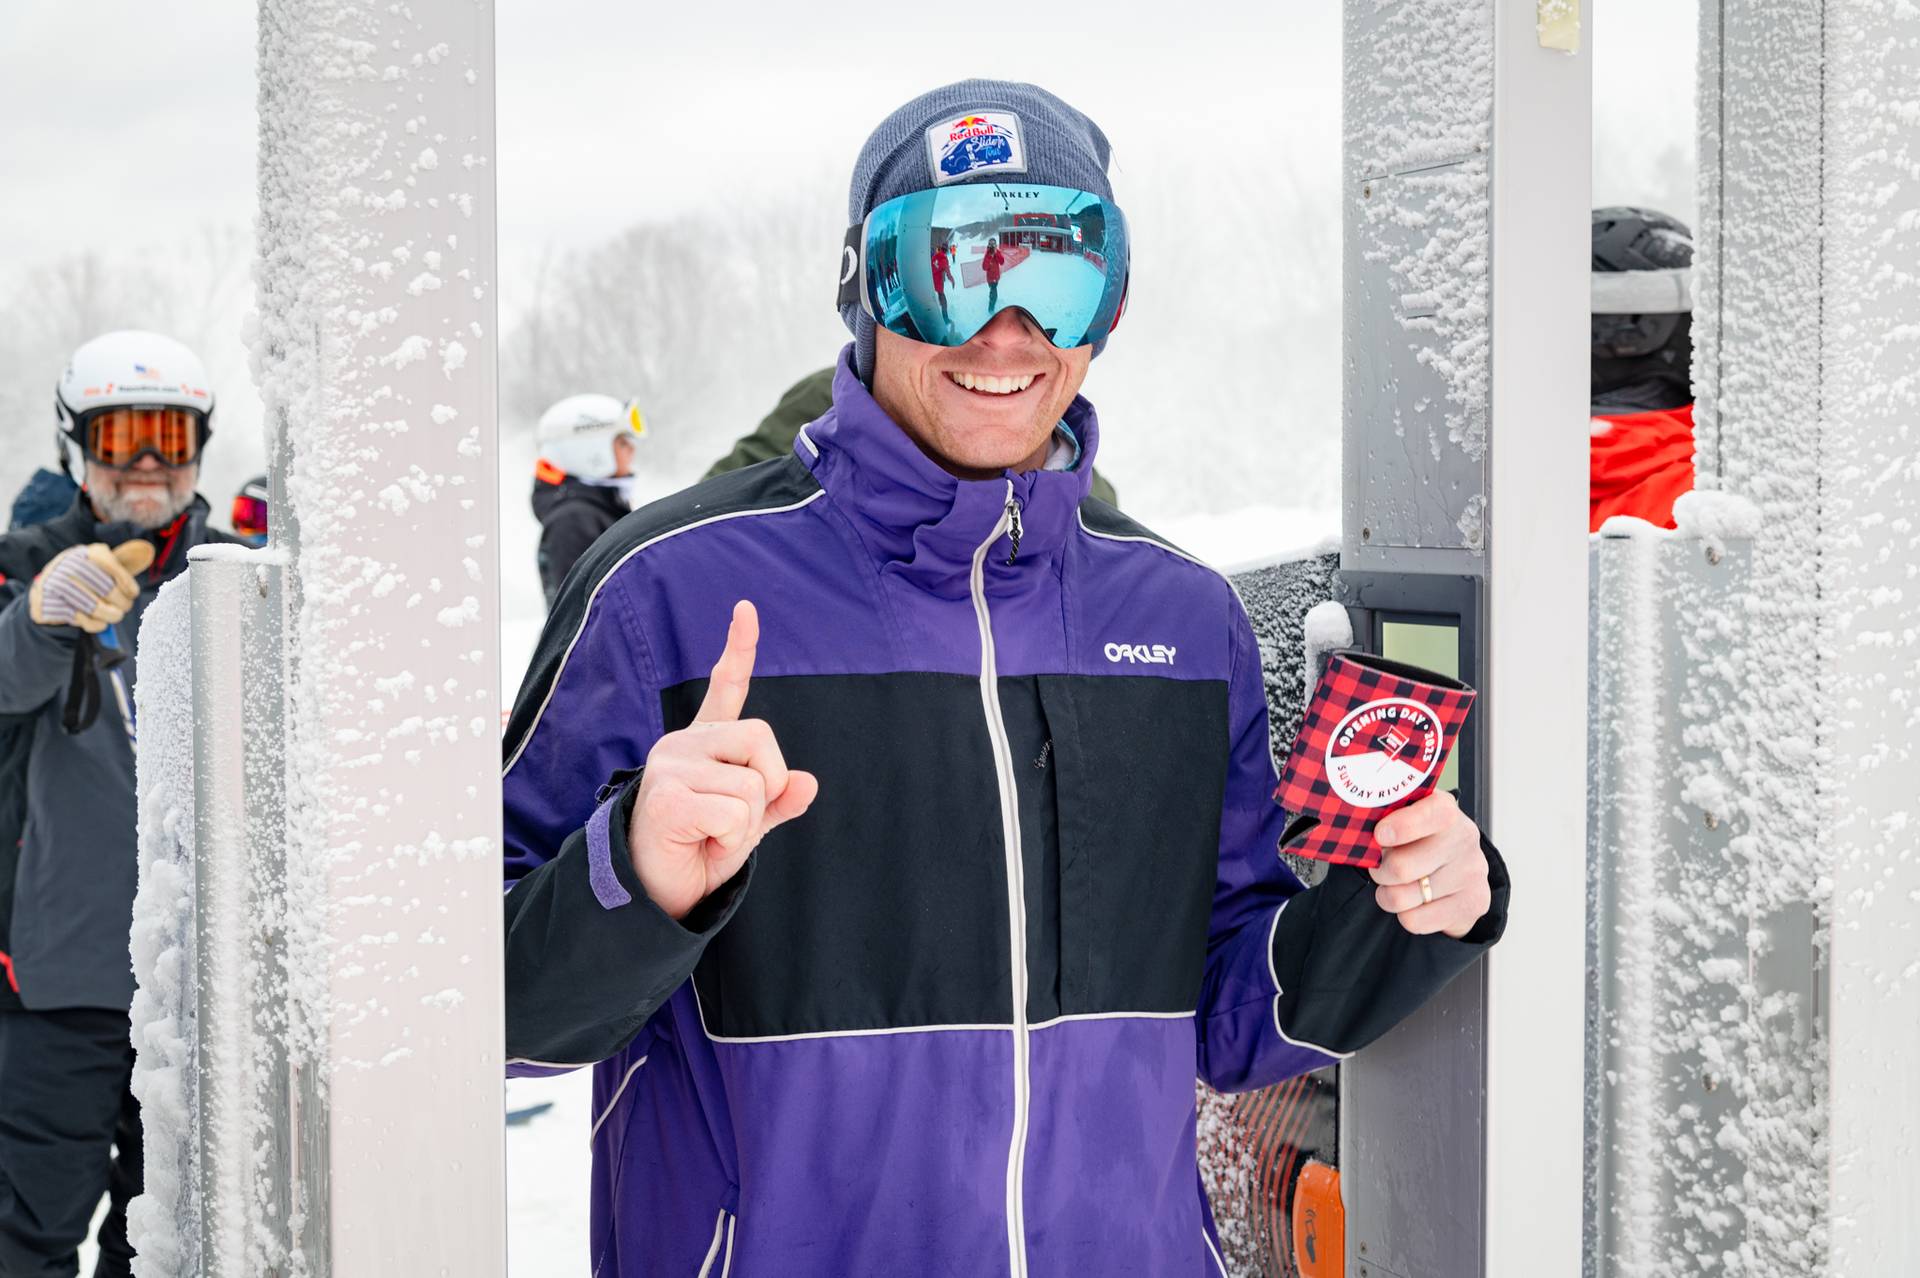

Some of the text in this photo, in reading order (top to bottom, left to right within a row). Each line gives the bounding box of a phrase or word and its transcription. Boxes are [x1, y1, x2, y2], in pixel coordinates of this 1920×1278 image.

[949, 125, 994, 141] Red Bull
[1104, 642, 1176, 665] OAKLEY
[1339, 707, 1396, 747] OPENING
[1400, 708, 1426, 725] DAY
[1423, 731, 1435, 761] 2023
[1337, 765, 1415, 798] SUNDAY RIVER
